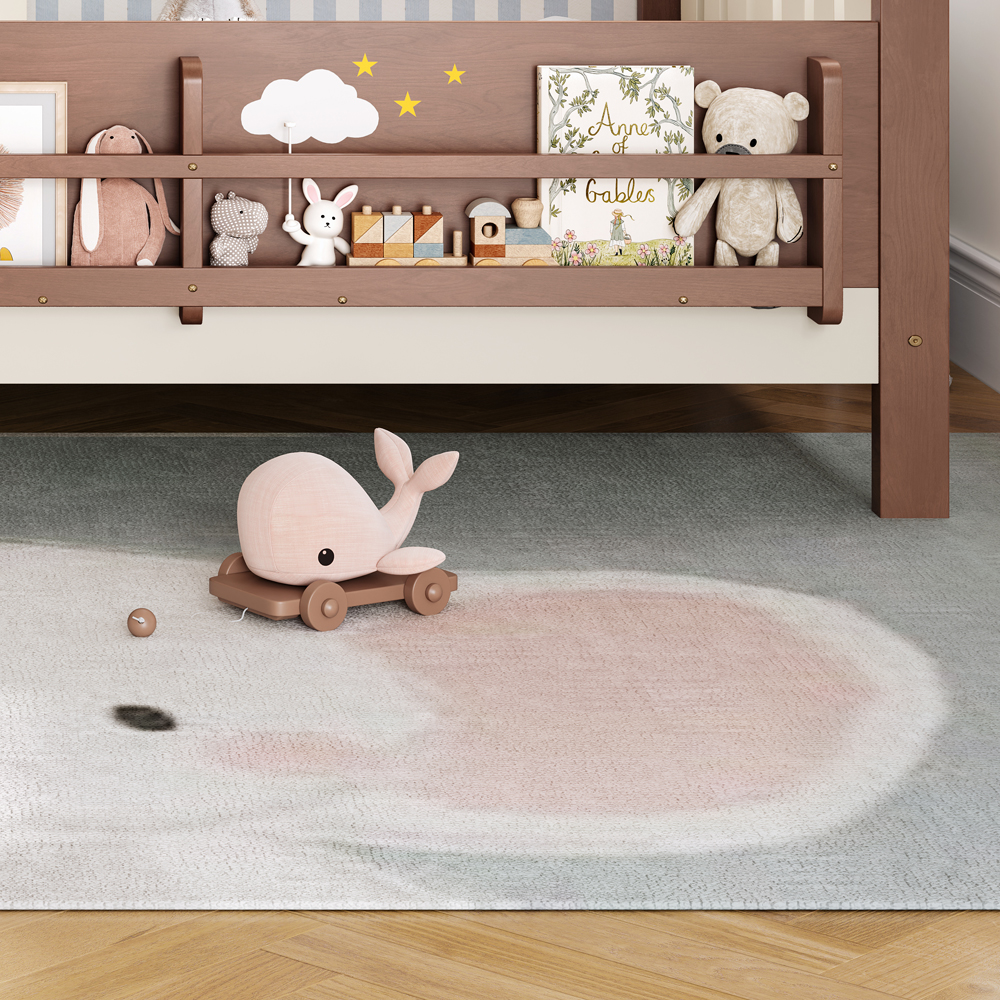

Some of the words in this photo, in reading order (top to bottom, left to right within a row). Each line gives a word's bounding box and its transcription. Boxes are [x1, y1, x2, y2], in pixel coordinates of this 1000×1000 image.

[588, 101, 650, 137] Anne
[612, 135, 629, 155] of
[585, 177, 656, 204] Gables
